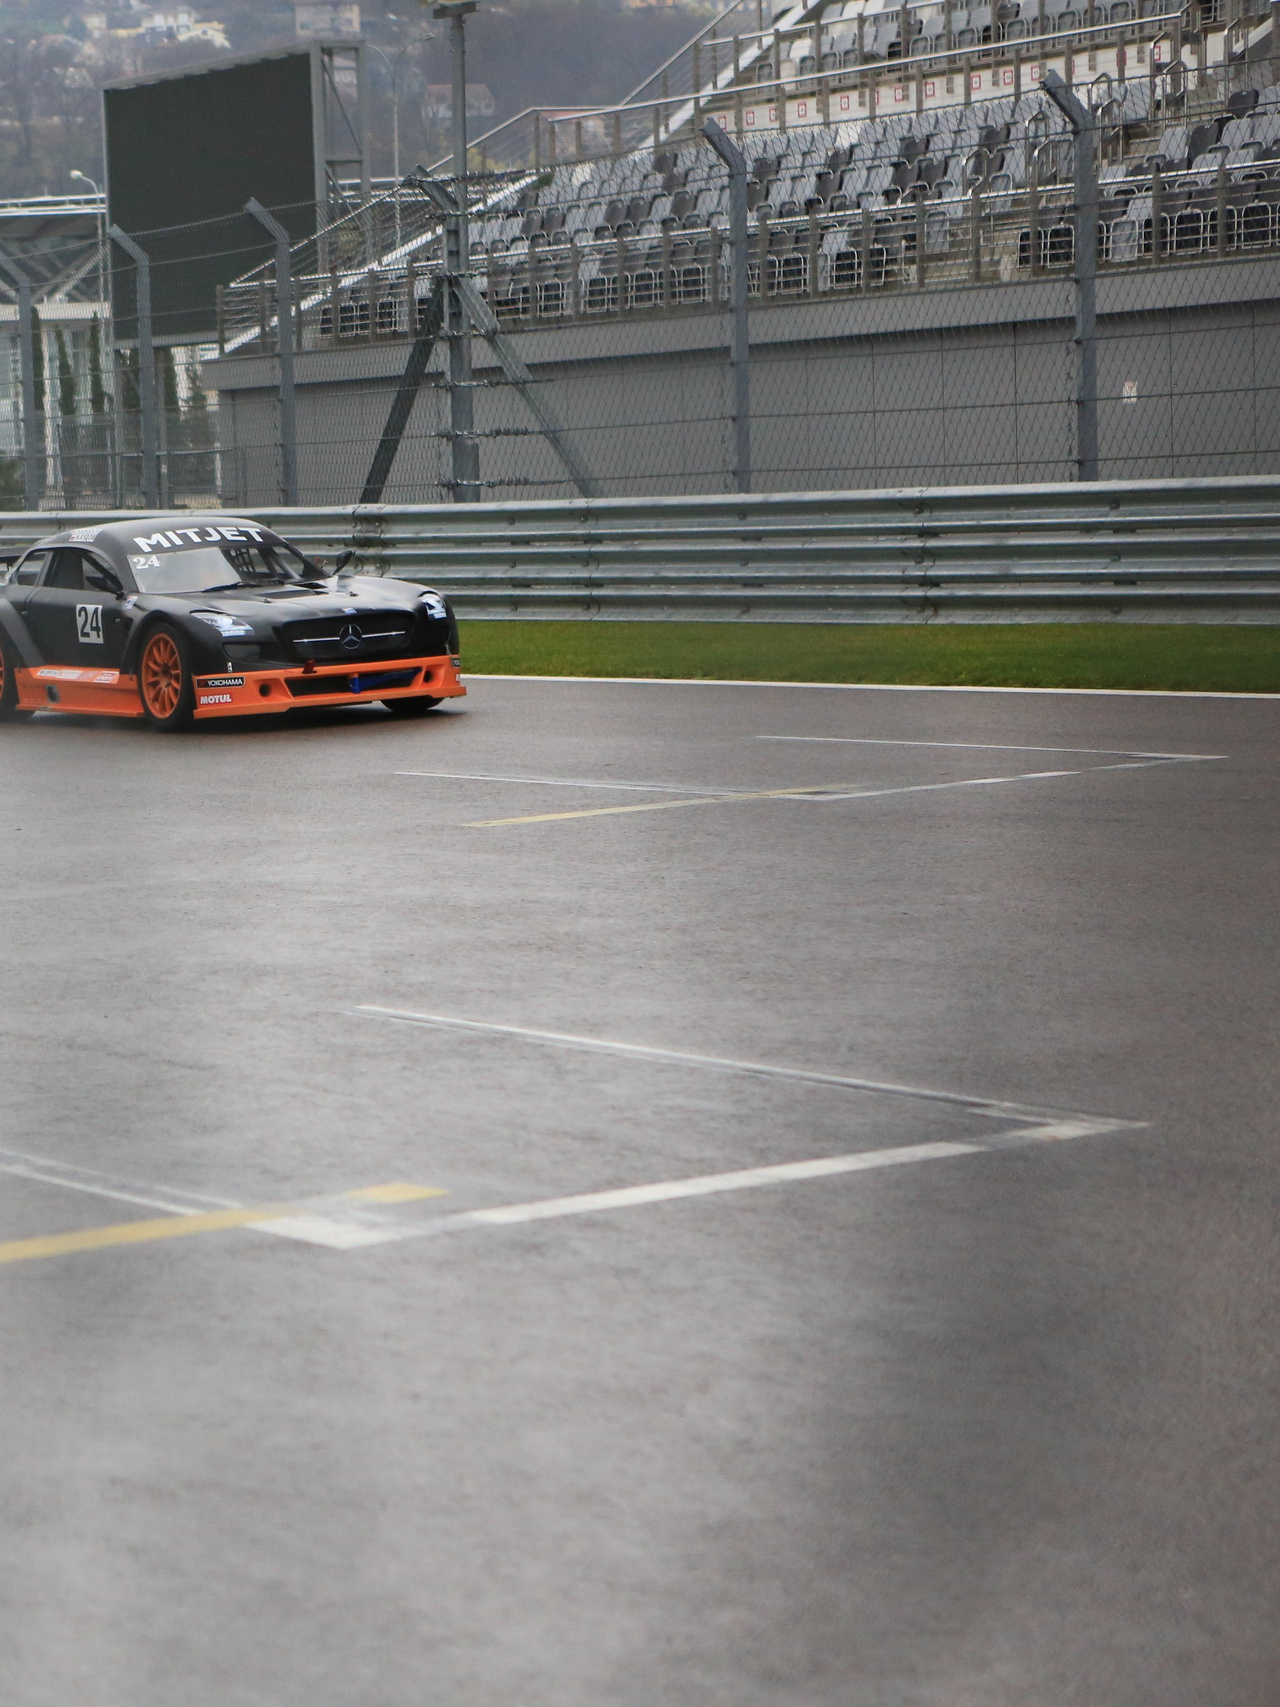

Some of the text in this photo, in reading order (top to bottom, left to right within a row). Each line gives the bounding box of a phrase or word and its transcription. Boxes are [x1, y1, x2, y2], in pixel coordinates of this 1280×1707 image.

[132, 526, 264, 553] MITJET
[133, 555, 161, 570] 24
[78, 606, 101, 639] 24
[207, 678, 243, 687] YOKOHAMA
[200, 694, 232, 705] MOTUL
